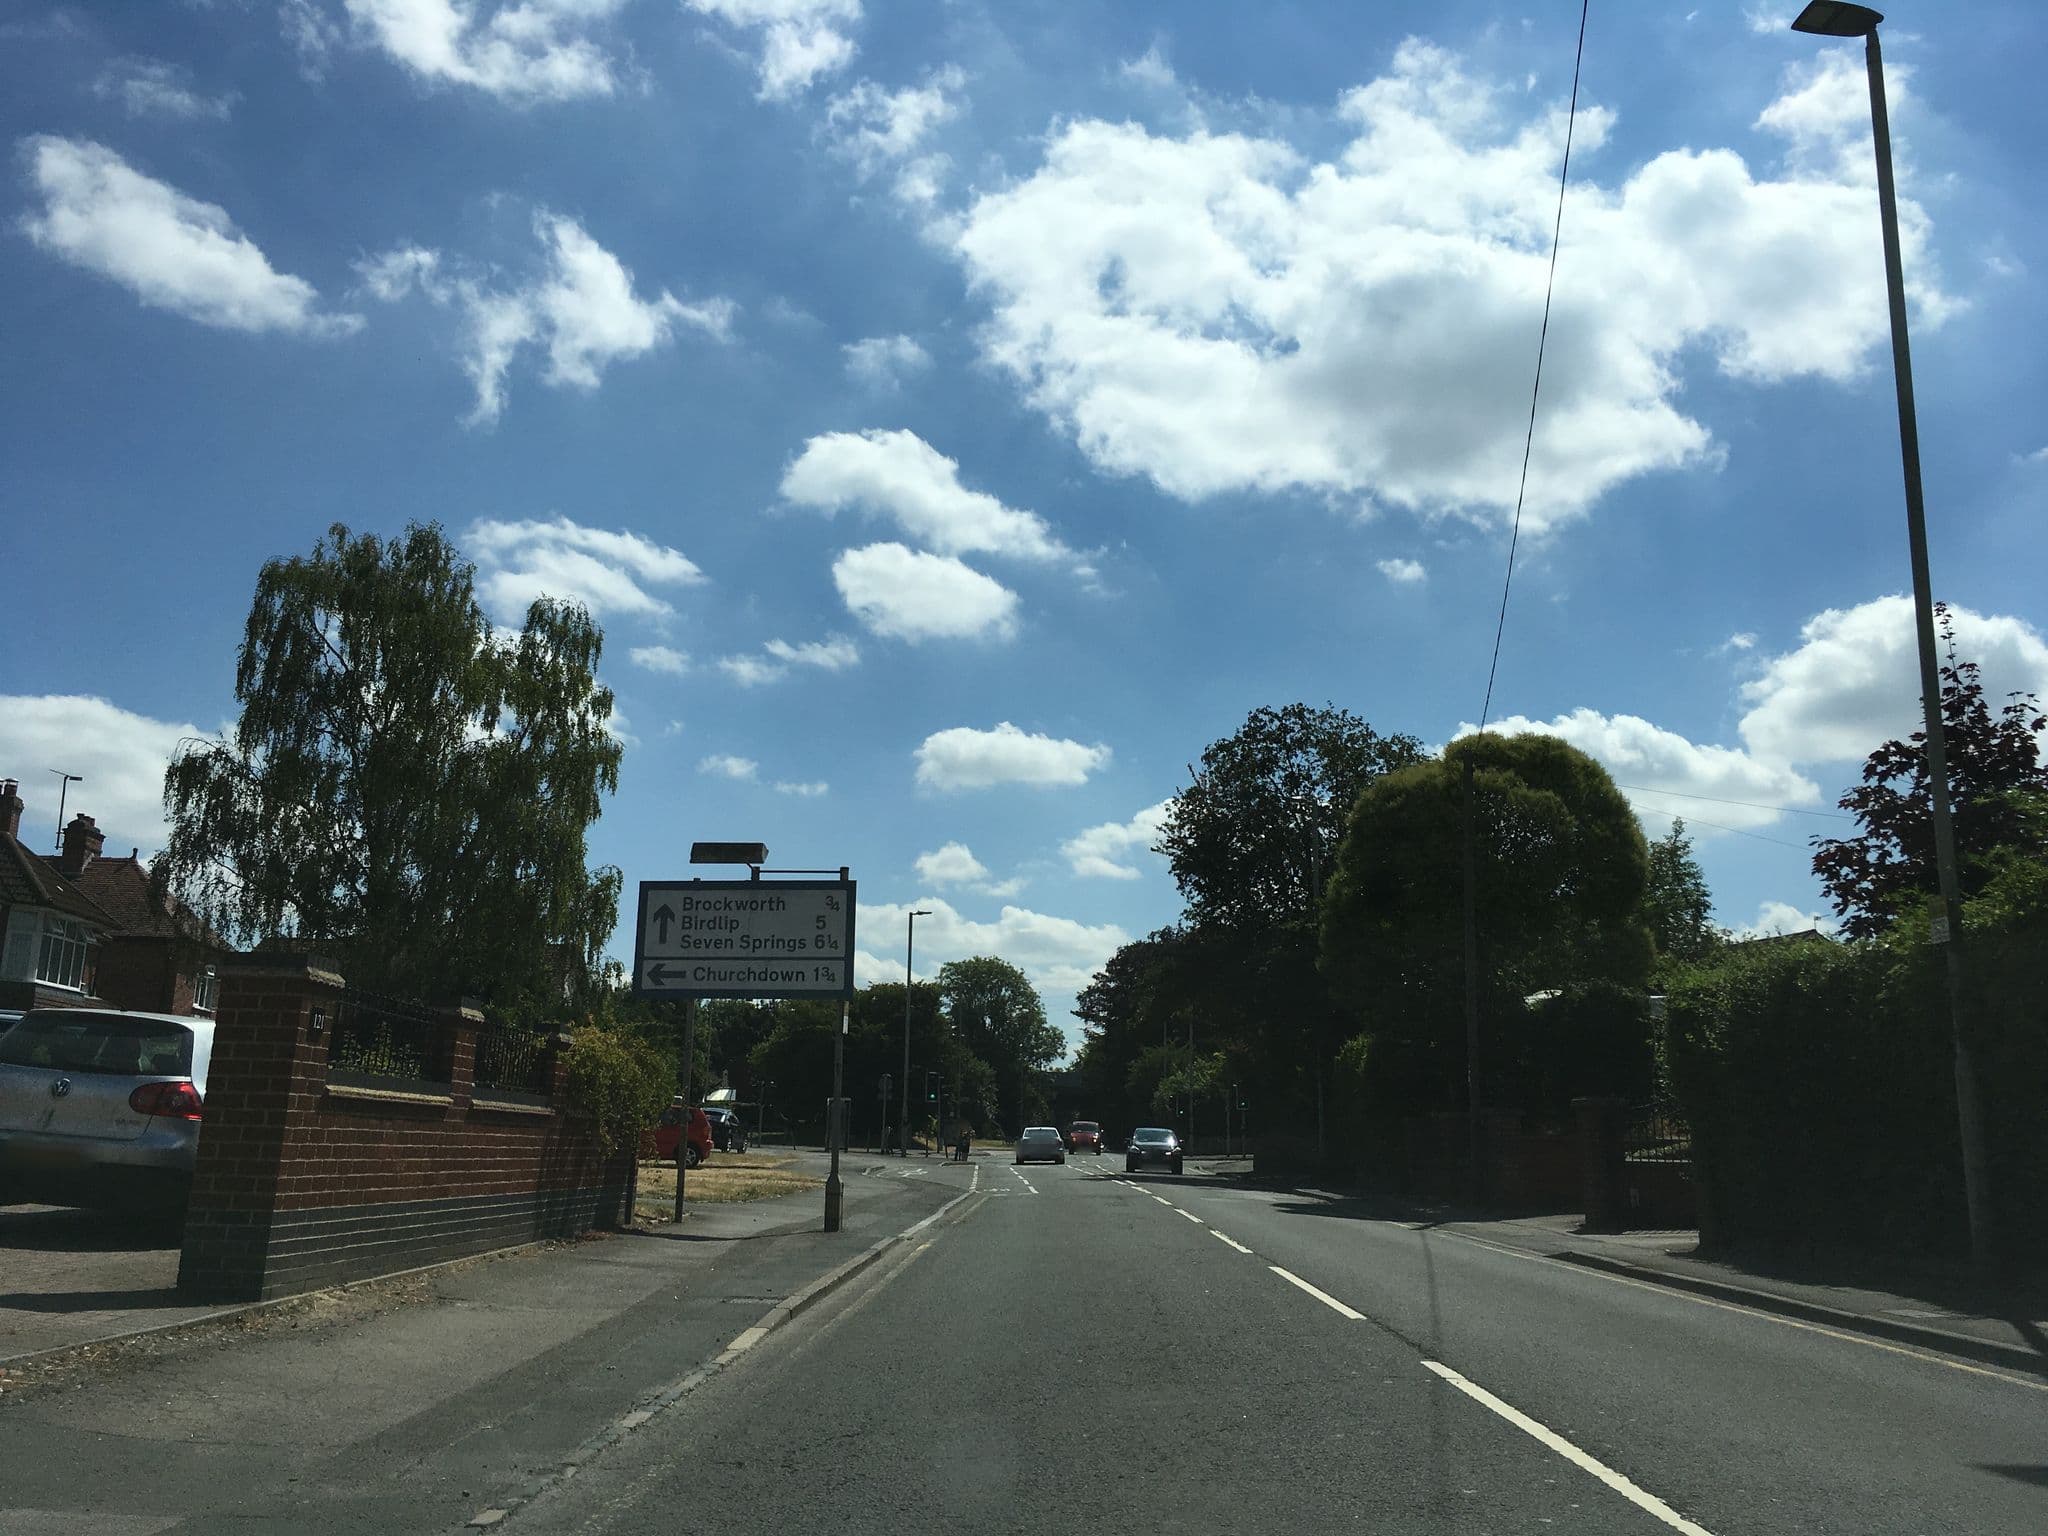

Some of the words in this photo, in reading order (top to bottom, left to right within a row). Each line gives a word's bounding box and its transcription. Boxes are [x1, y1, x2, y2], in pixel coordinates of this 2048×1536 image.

[682, 896, 786, 911] Brockworth
[681, 915, 740, 933] Birdlip
[815, 915, 827, 930] 5
[680, 935, 734, 949] Seven
[739, 935, 807, 952] Springs
[693, 967, 806, 982] Churchdown
[313, 1013, 325, 1030] 121
